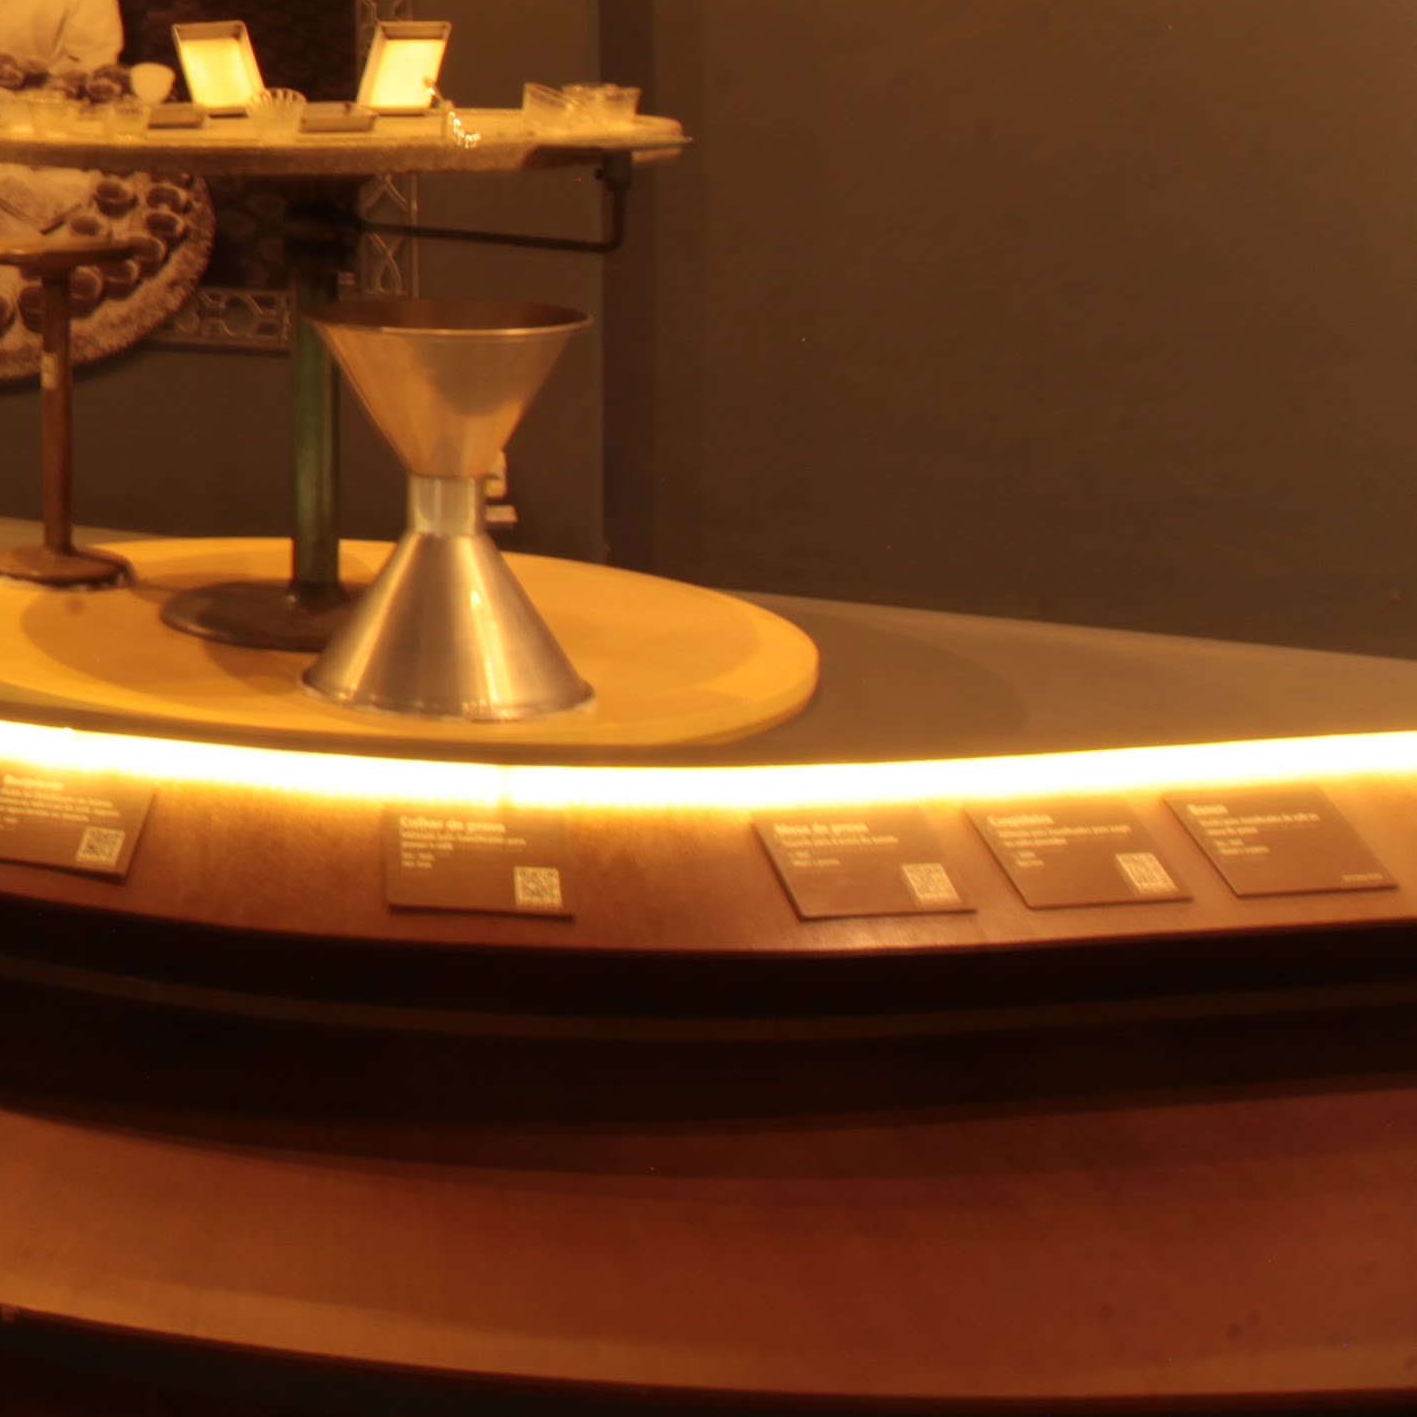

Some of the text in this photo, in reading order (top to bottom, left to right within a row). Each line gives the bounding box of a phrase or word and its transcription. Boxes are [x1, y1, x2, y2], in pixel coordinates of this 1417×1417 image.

[399, 816, 506, 833] Colher de prova
